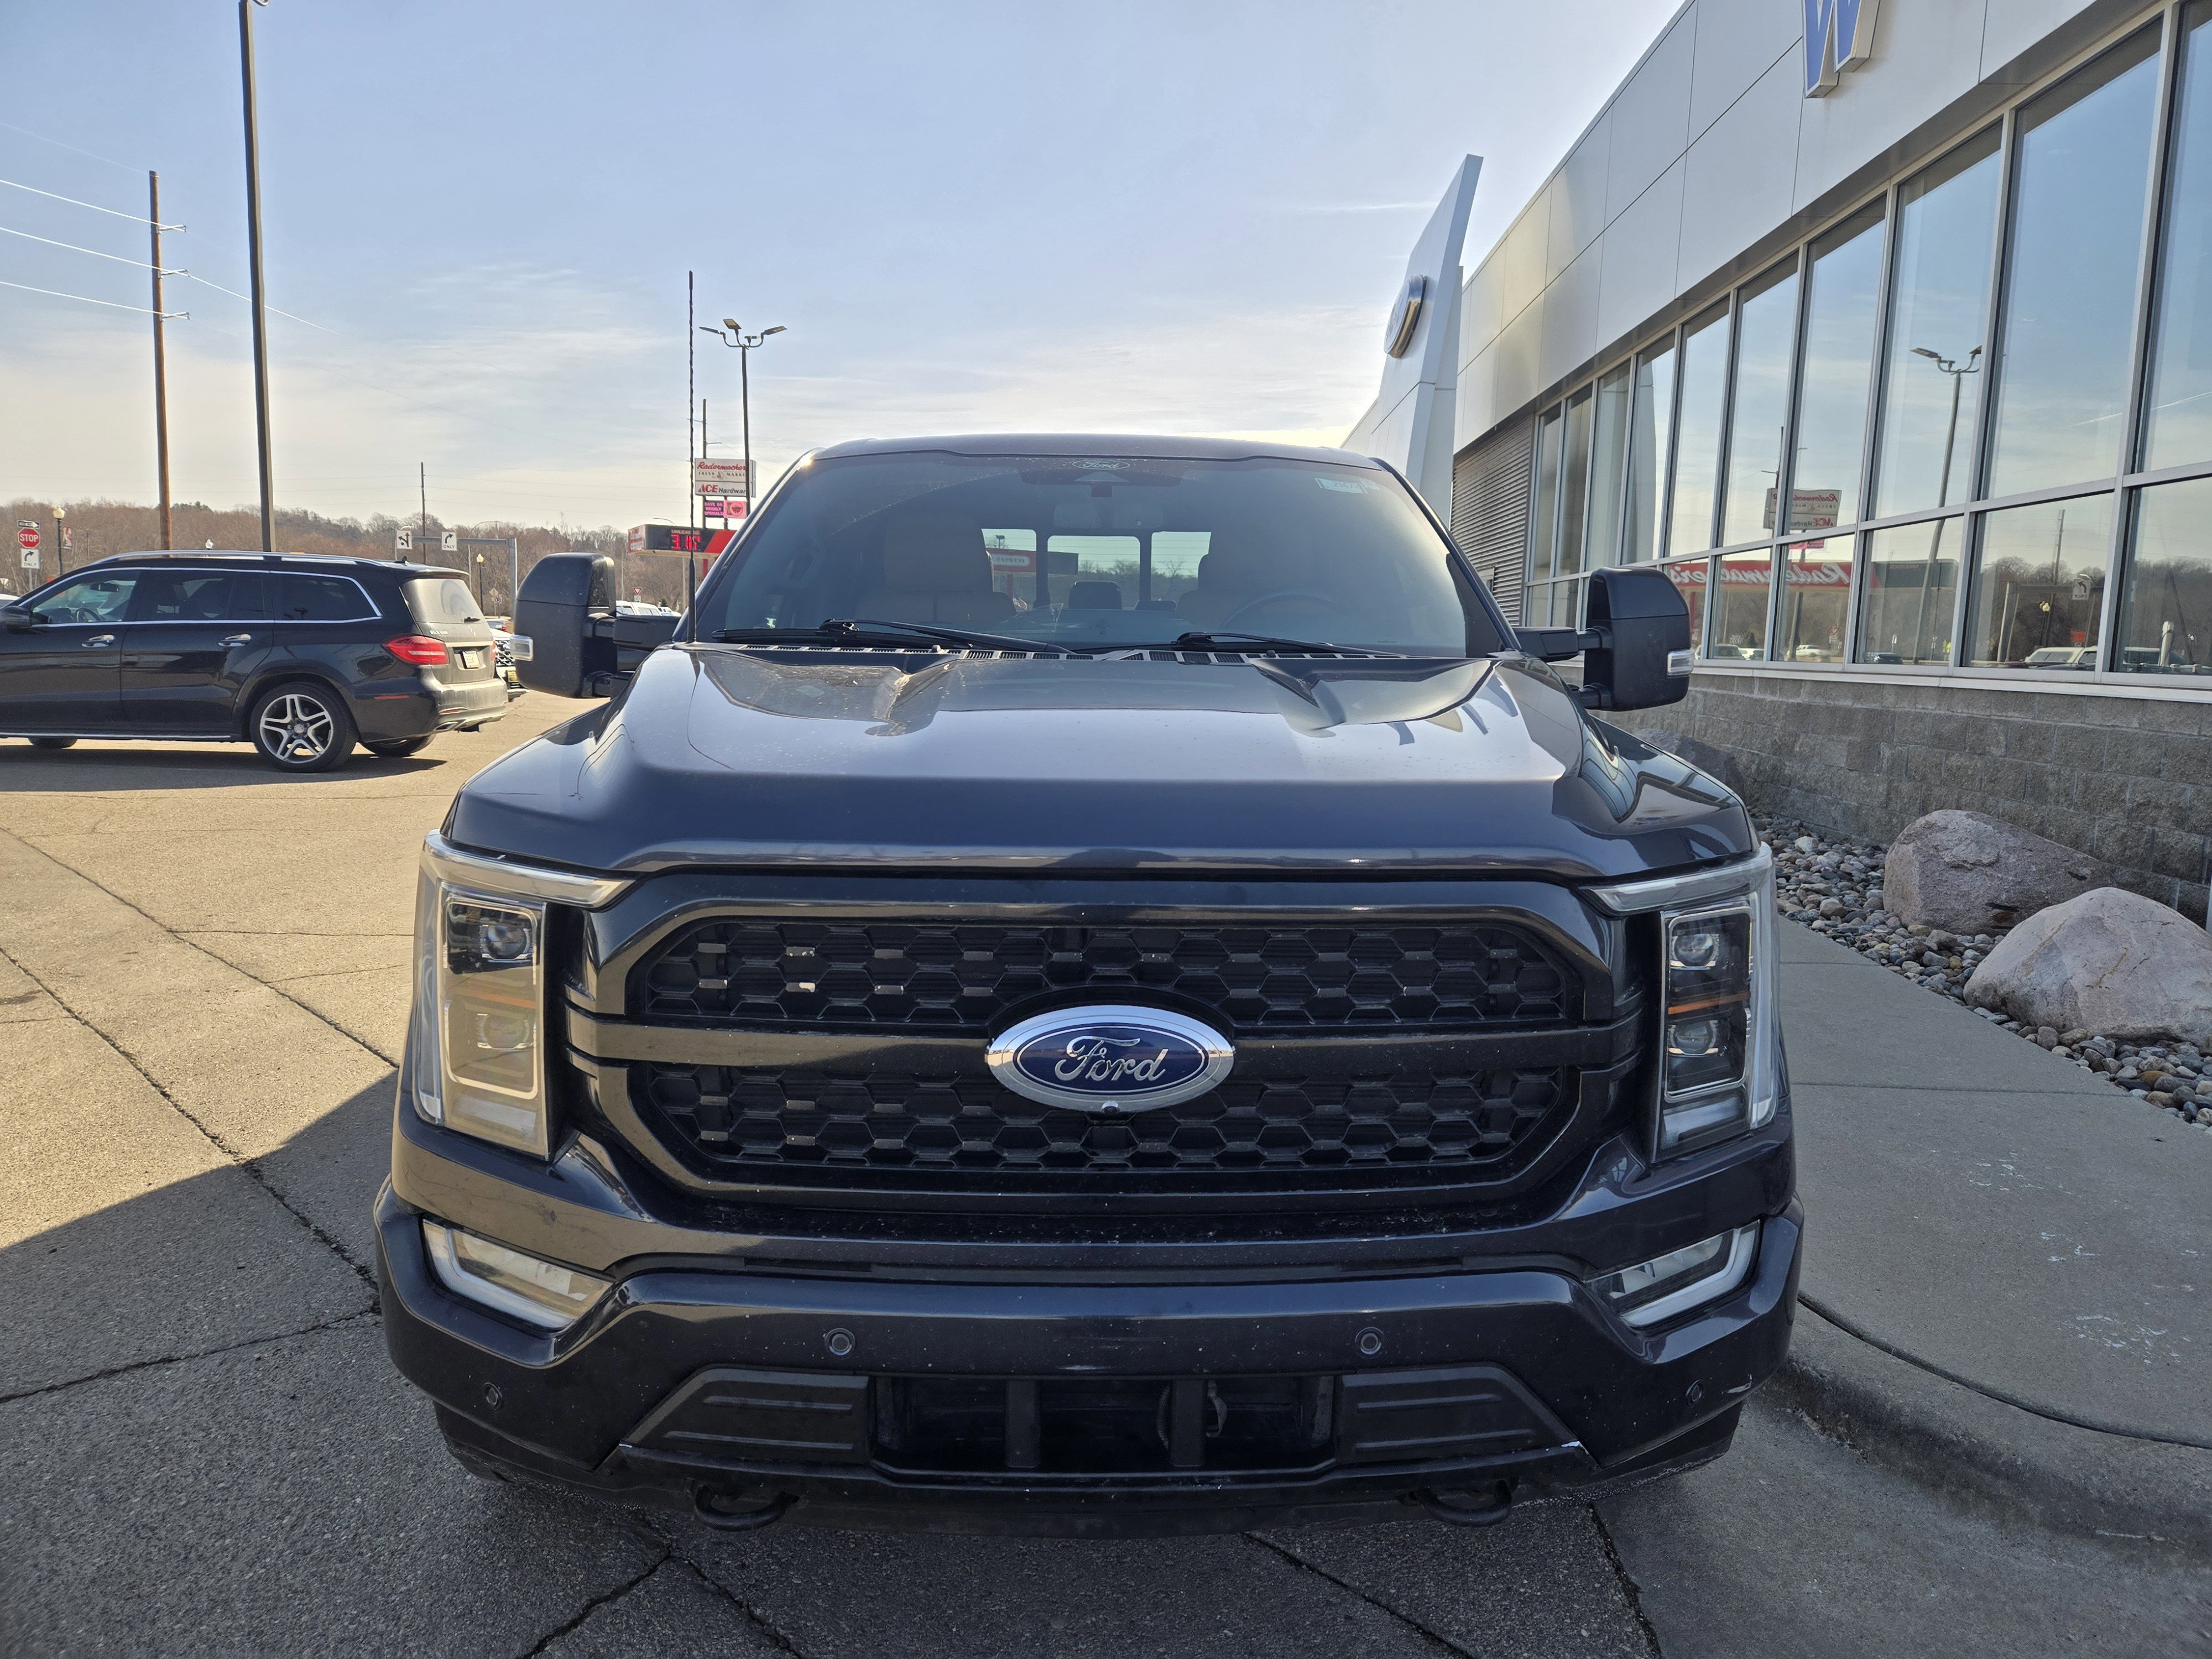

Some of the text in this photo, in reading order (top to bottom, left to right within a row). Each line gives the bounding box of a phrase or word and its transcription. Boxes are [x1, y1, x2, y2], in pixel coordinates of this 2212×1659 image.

[697, 461, 746, 471] Radermacher
[698, 484, 718, 493] ACE
[19, 534, 39, 542] STOP
[1055, 1035, 1169, 1081] Ford
